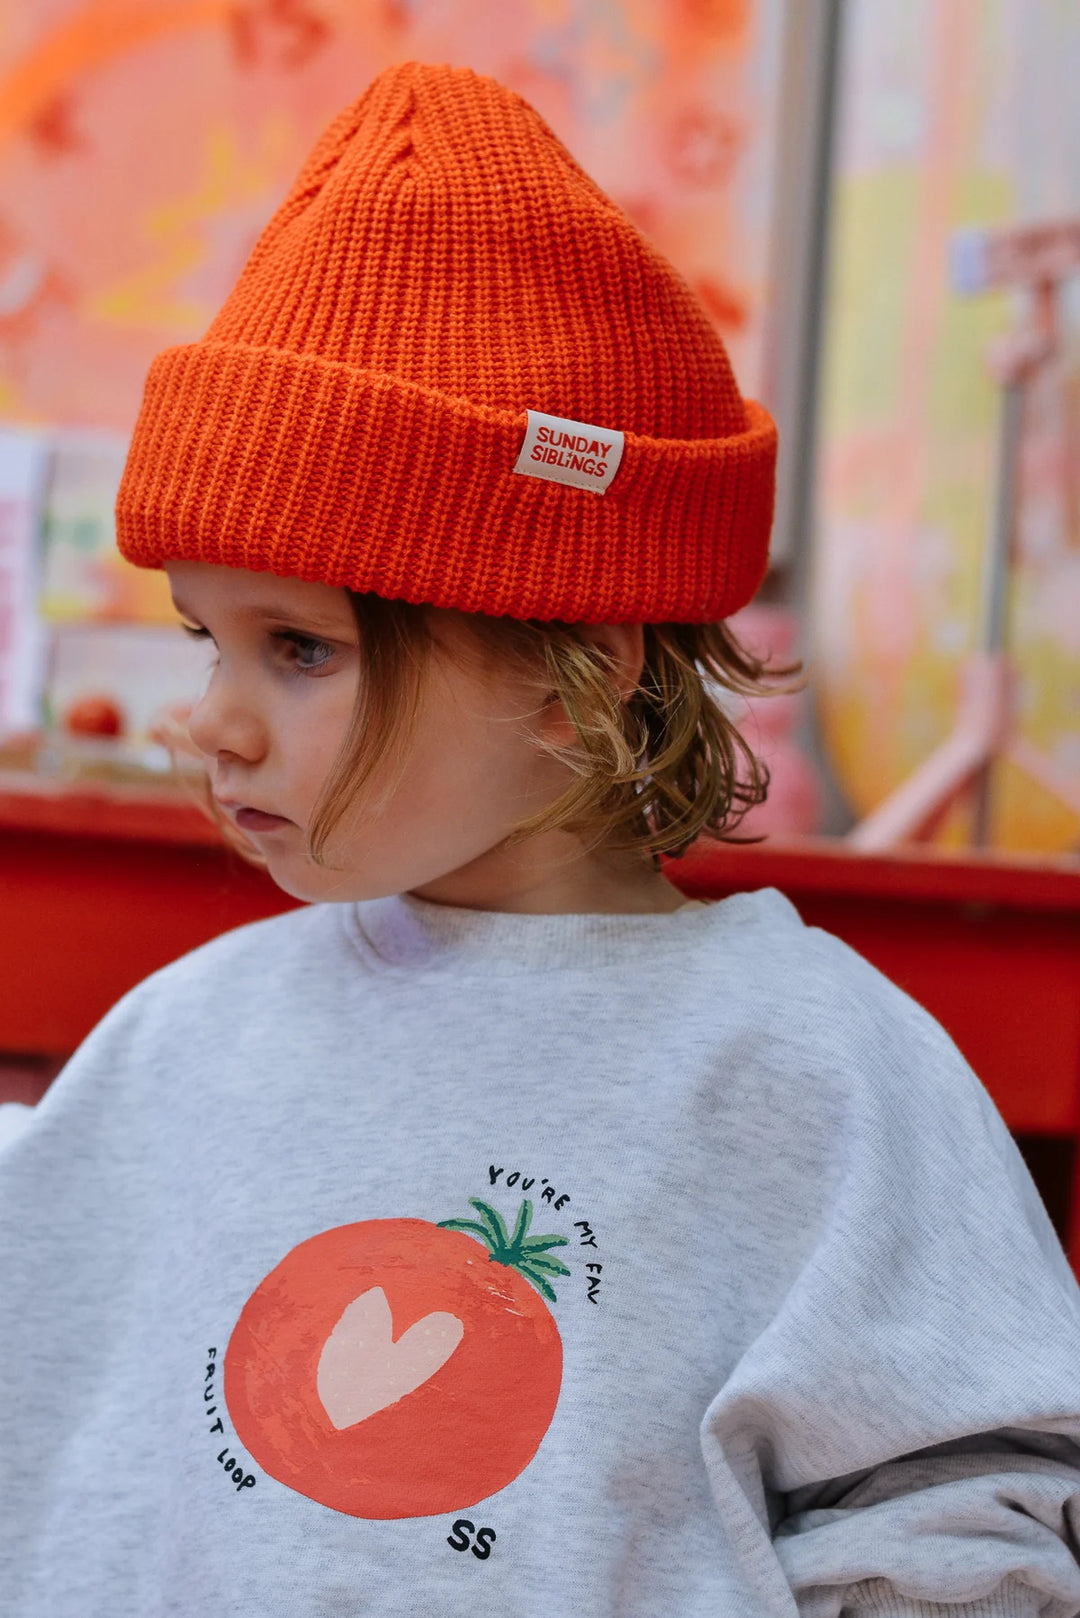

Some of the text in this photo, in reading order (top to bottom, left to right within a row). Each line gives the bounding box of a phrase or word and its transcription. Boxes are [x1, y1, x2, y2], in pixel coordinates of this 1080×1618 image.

[536, 426, 612, 459] SUNDAY
[489, 1165, 603, 1305] YOU'RE MY FAV
[204, 1347, 256, 1491] FRUIT LOOP
[446, 1519, 497, 1560] SS
